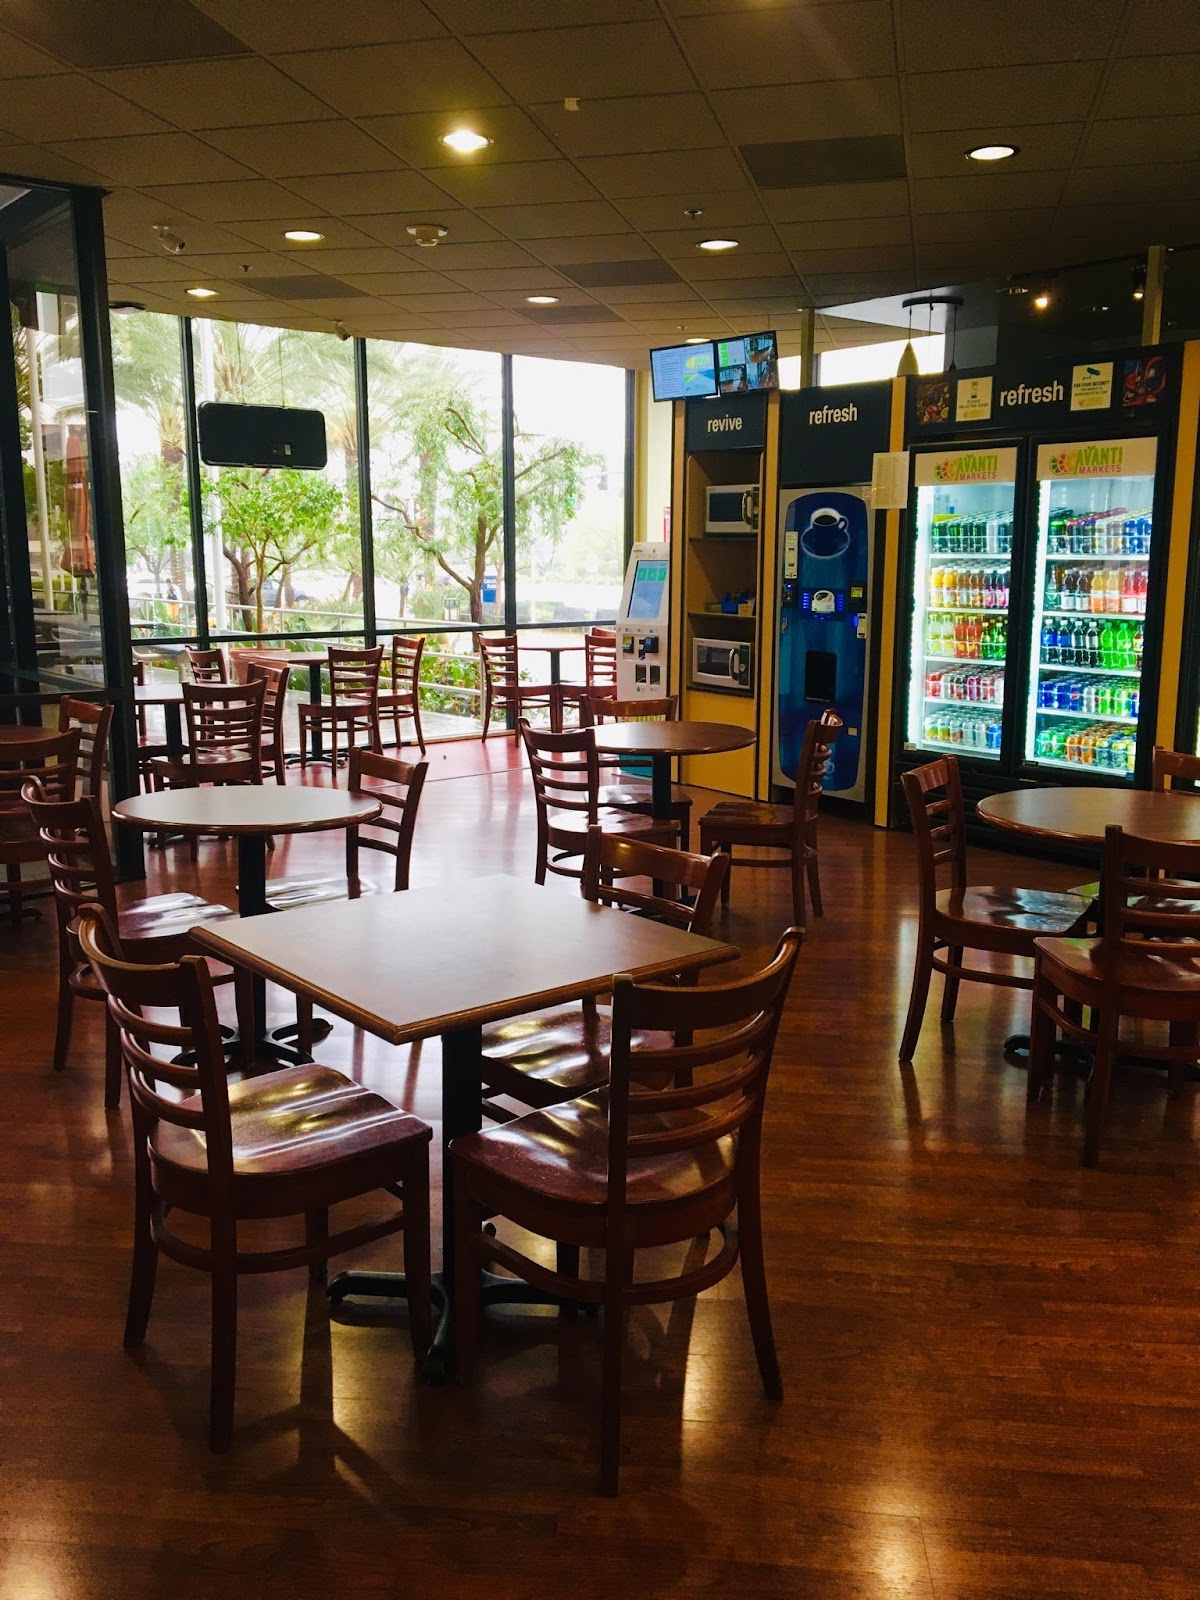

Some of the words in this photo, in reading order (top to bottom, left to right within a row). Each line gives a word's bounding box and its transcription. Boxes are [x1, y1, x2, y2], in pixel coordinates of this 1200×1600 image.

[1000, 380, 1064, 406] refresh
[707, 413, 743, 432] revive
[809, 402, 858, 425] refresh
[956, 454, 998, 481] AVANTI
[1073, 446, 1123, 475] AVANTI
[1078, 464, 1122, 475] MARKETS
[959, 471, 997, 481] MARKETS
